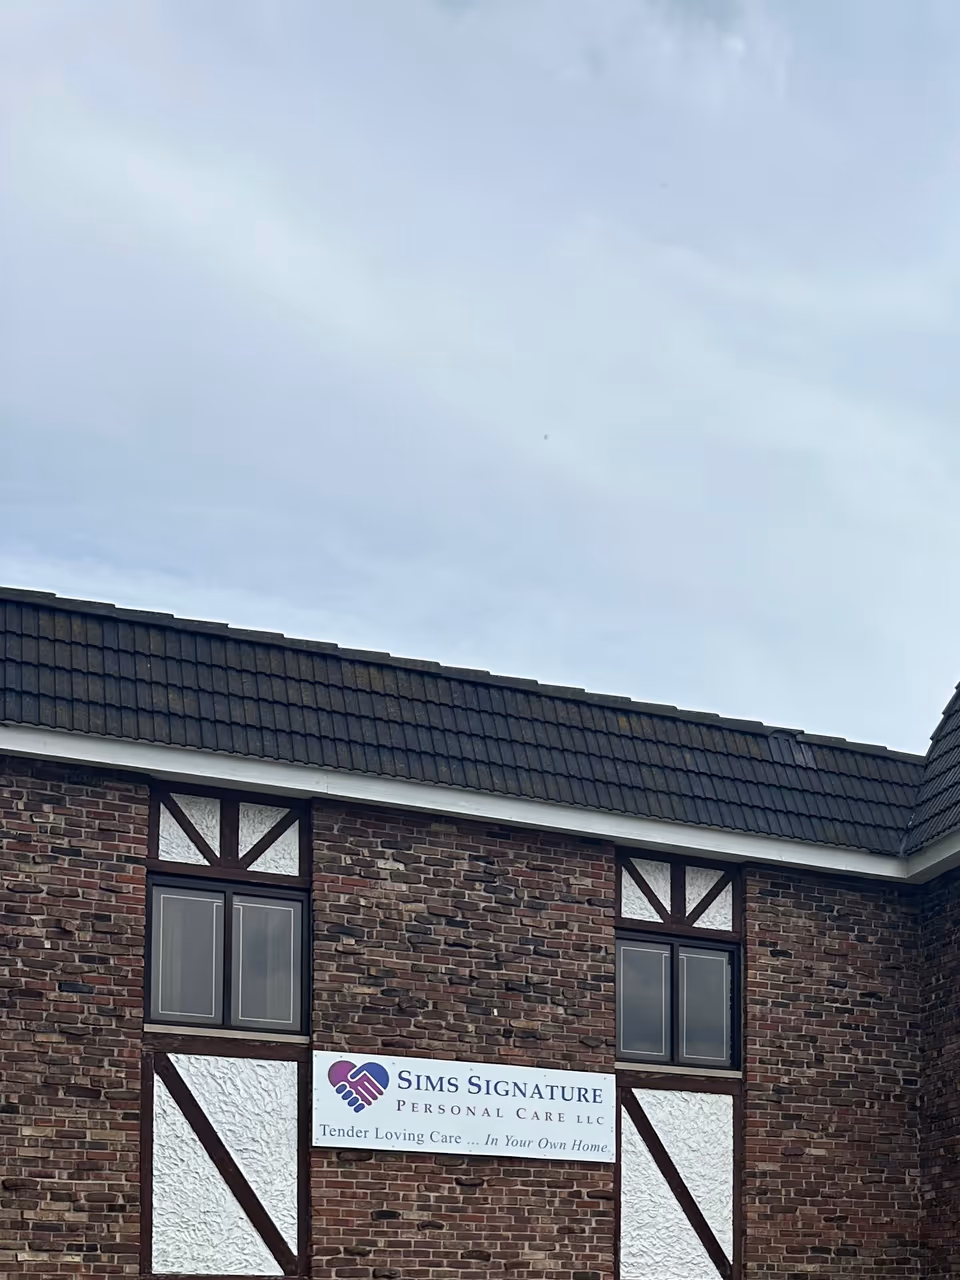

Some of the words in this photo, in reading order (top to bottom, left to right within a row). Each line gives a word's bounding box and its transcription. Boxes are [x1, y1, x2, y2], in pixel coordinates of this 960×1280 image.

[576, 1115, 605, 1126] LLC
[319, 1123, 369, 1139] Tender
[375, 1127, 425, 1146] Loving
[430, 1130, 462, 1144] Care
[484, 1133, 499, 1146] In
[505, 1134, 534, 1148] Your
[537, 1137, 567, 1151] Own
